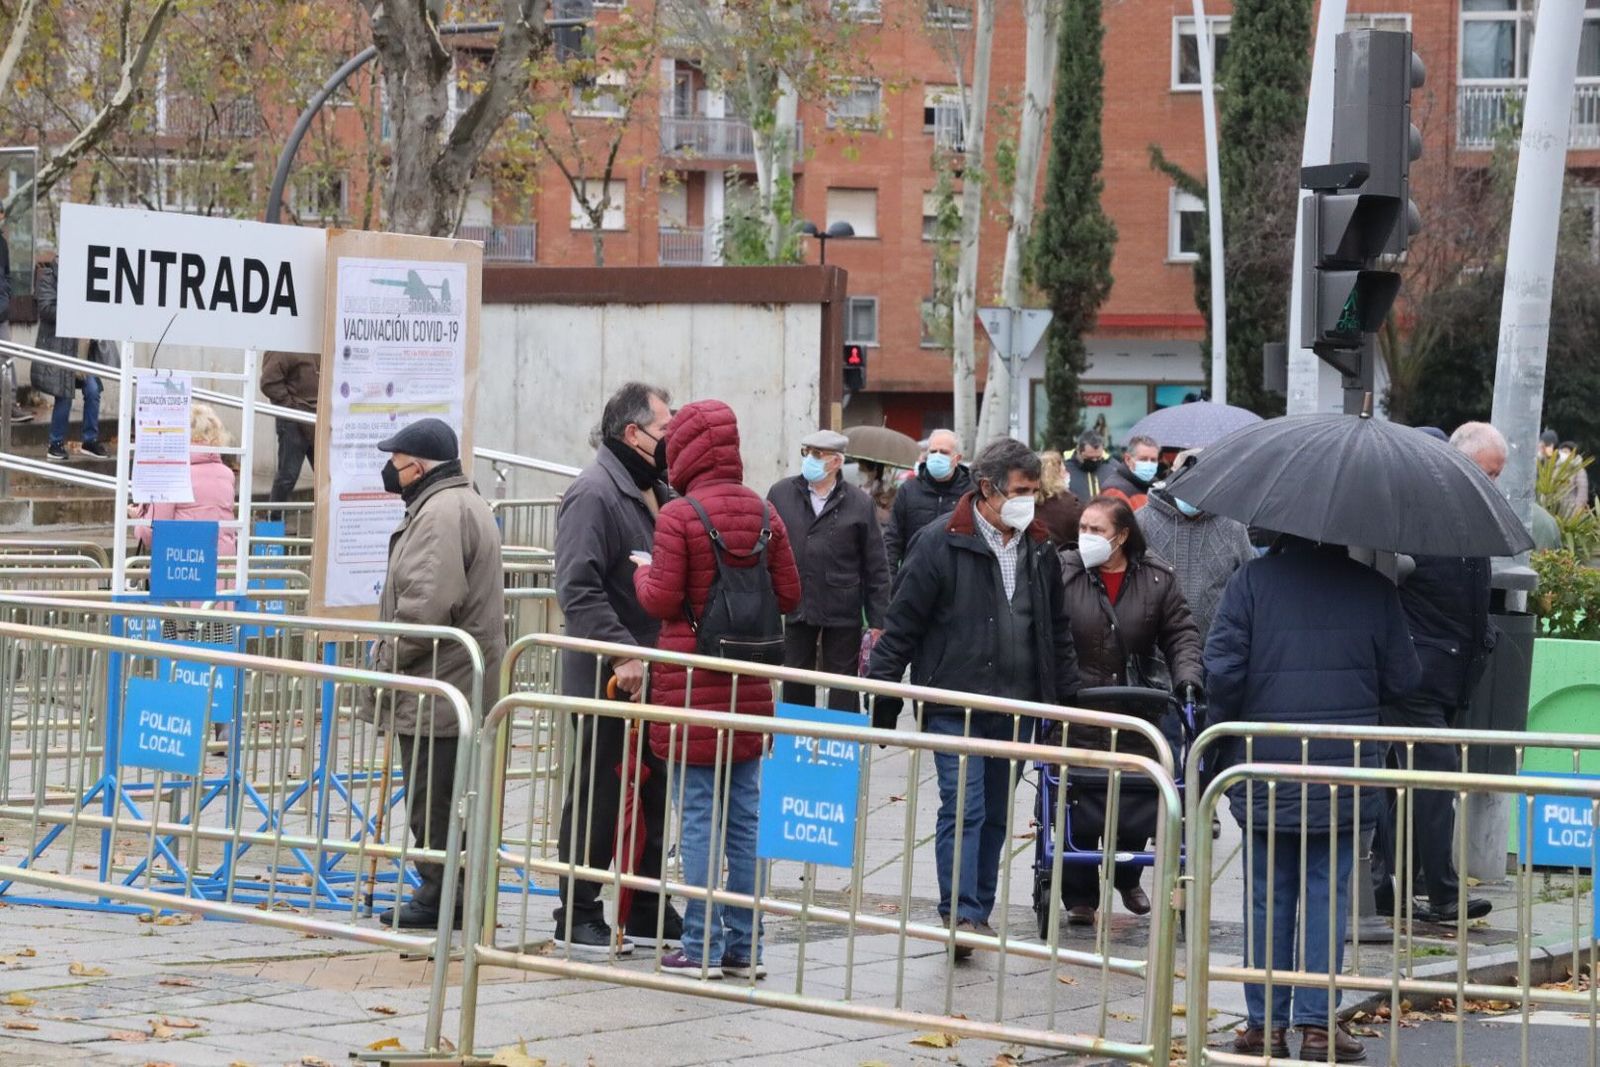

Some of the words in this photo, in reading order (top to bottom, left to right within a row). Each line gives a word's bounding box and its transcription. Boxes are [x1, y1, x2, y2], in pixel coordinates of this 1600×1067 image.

[86, 244, 299, 317] ENTRADA
[344, 314, 409, 342] VACUNACIÓN
[412, 320, 459, 343] COVID-19
[166, 547, 204, 564] POLICIA
[167, 566, 201, 582] LOCAL
[256, 600, 283, 610] PLICIA
[174, 668, 223, 689] POLICA
[139, 709, 192, 737] POLICIA
[139, 732, 185, 758] LOCAL
[782, 796, 845, 823] POLICIA
[784, 821, 839, 846] LOCAL
